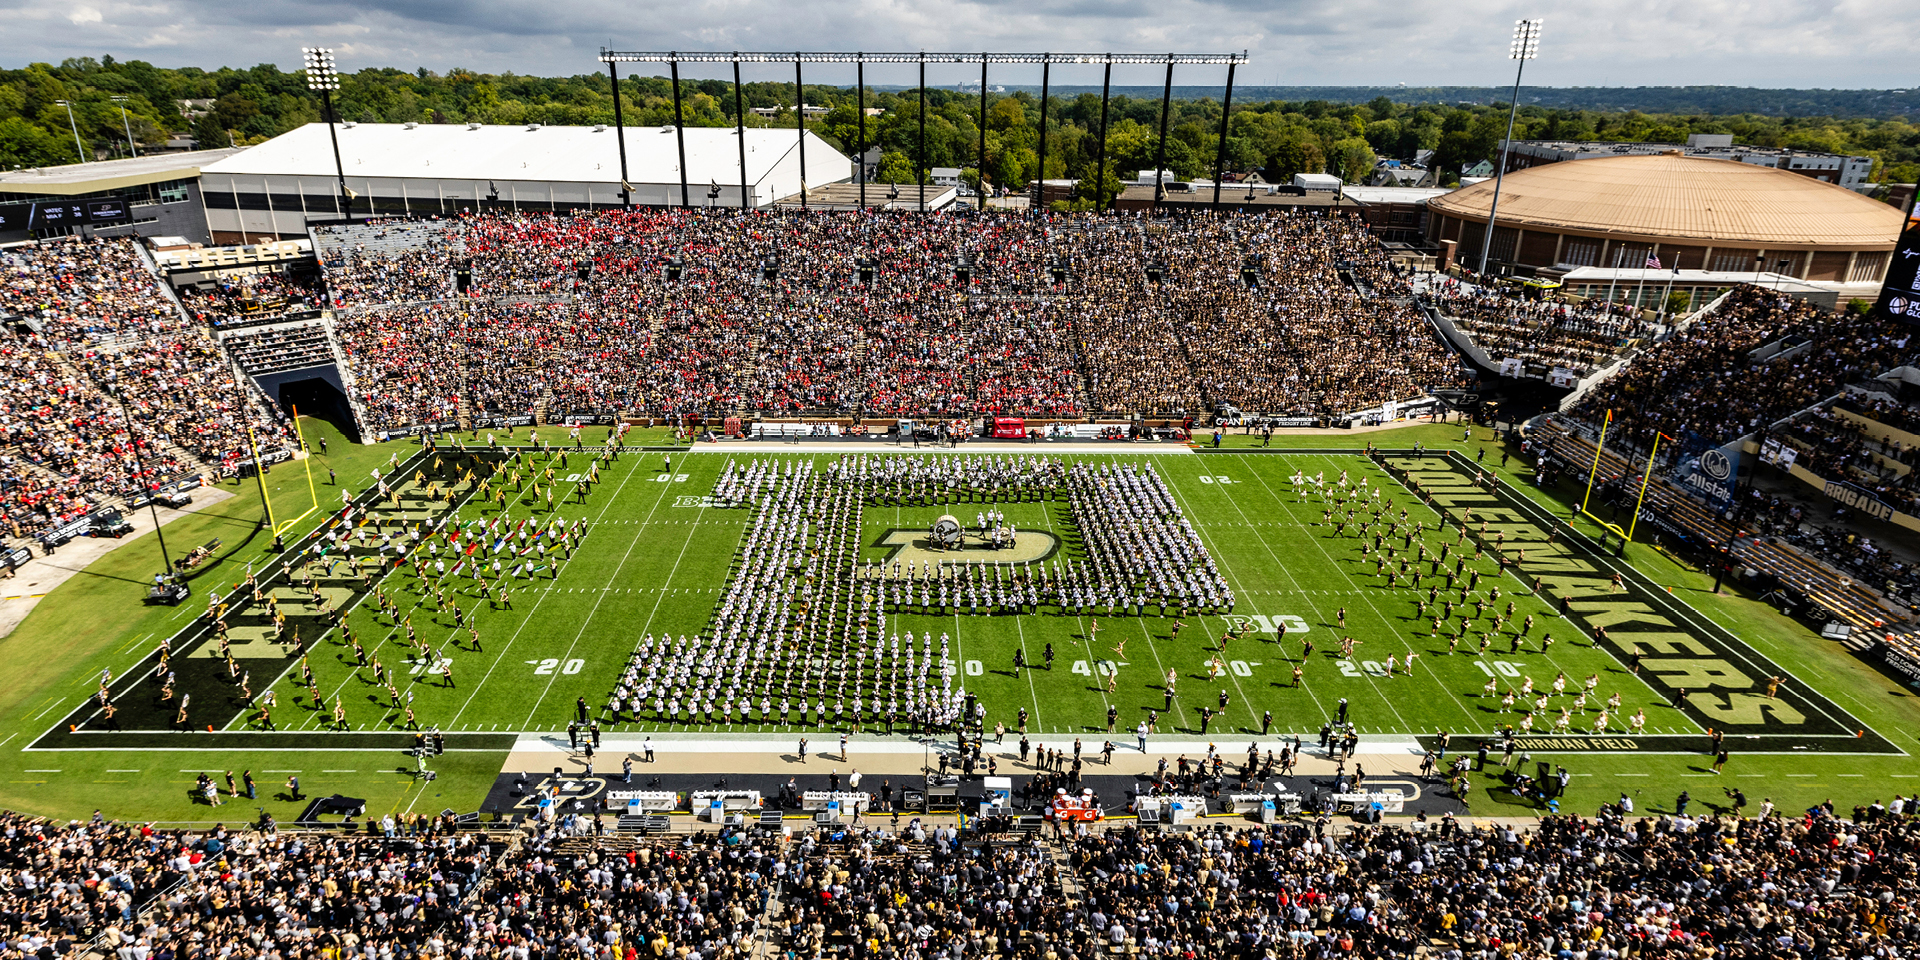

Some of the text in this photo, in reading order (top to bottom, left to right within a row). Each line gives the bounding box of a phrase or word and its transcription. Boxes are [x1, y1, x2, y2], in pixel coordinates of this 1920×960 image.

[172, 241, 301, 269] TILLER
[1684, 472, 1731, 503] Allstate
[1825, 483, 1892, 520] BRIGADE
[1385, 456, 1807, 725] BOILERMAKERS
[533, 658, 586, 675] 20
[1070, 660, 1119, 677] 40
[1335, 660, 1394, 677] 20
[1473, 660, 1522, 677] 10
[1513, 738, 1639, 750] OHRMAN FIELD
